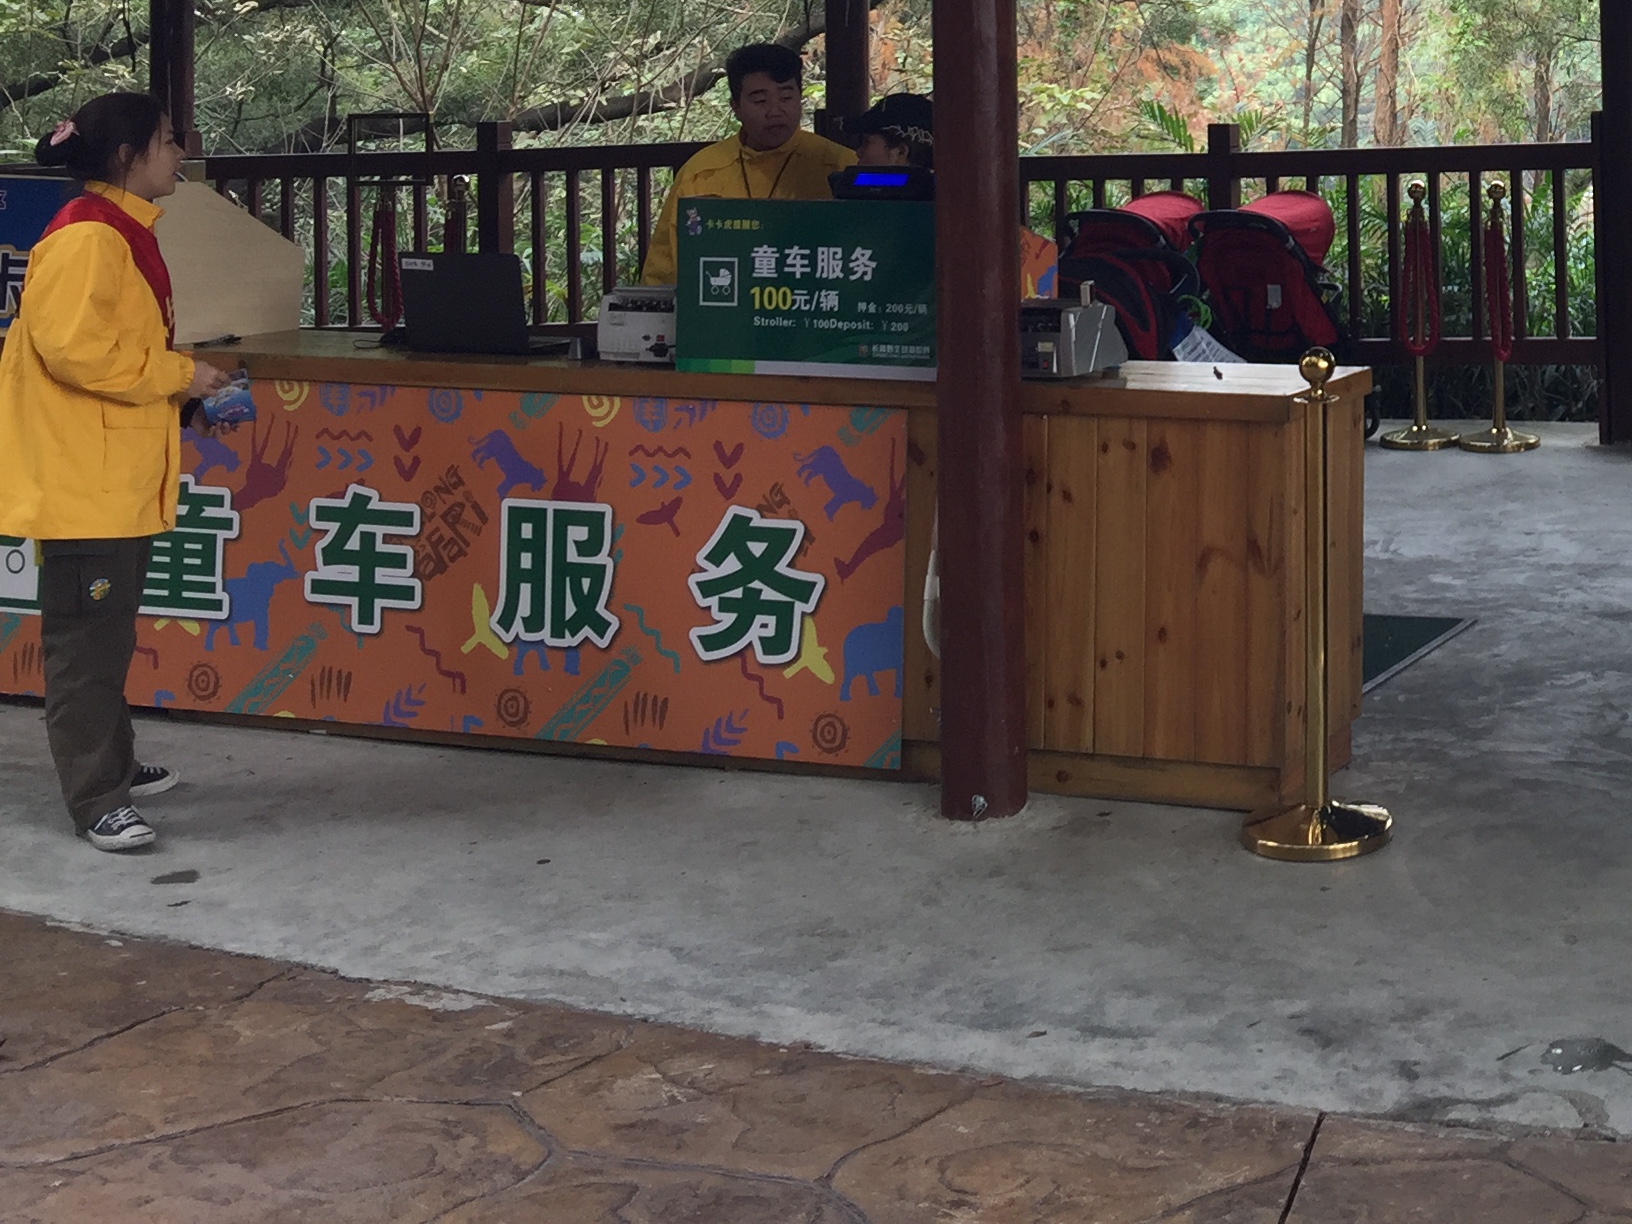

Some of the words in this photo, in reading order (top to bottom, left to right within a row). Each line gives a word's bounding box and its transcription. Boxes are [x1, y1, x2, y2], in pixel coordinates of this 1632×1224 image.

[750, 244, 878, 282] 童车服务
[749, 286, 840, 312] 100元/辆
[753, 316, 797, 327] Stroller:
[138, 474, 823, 663] 童车服务
